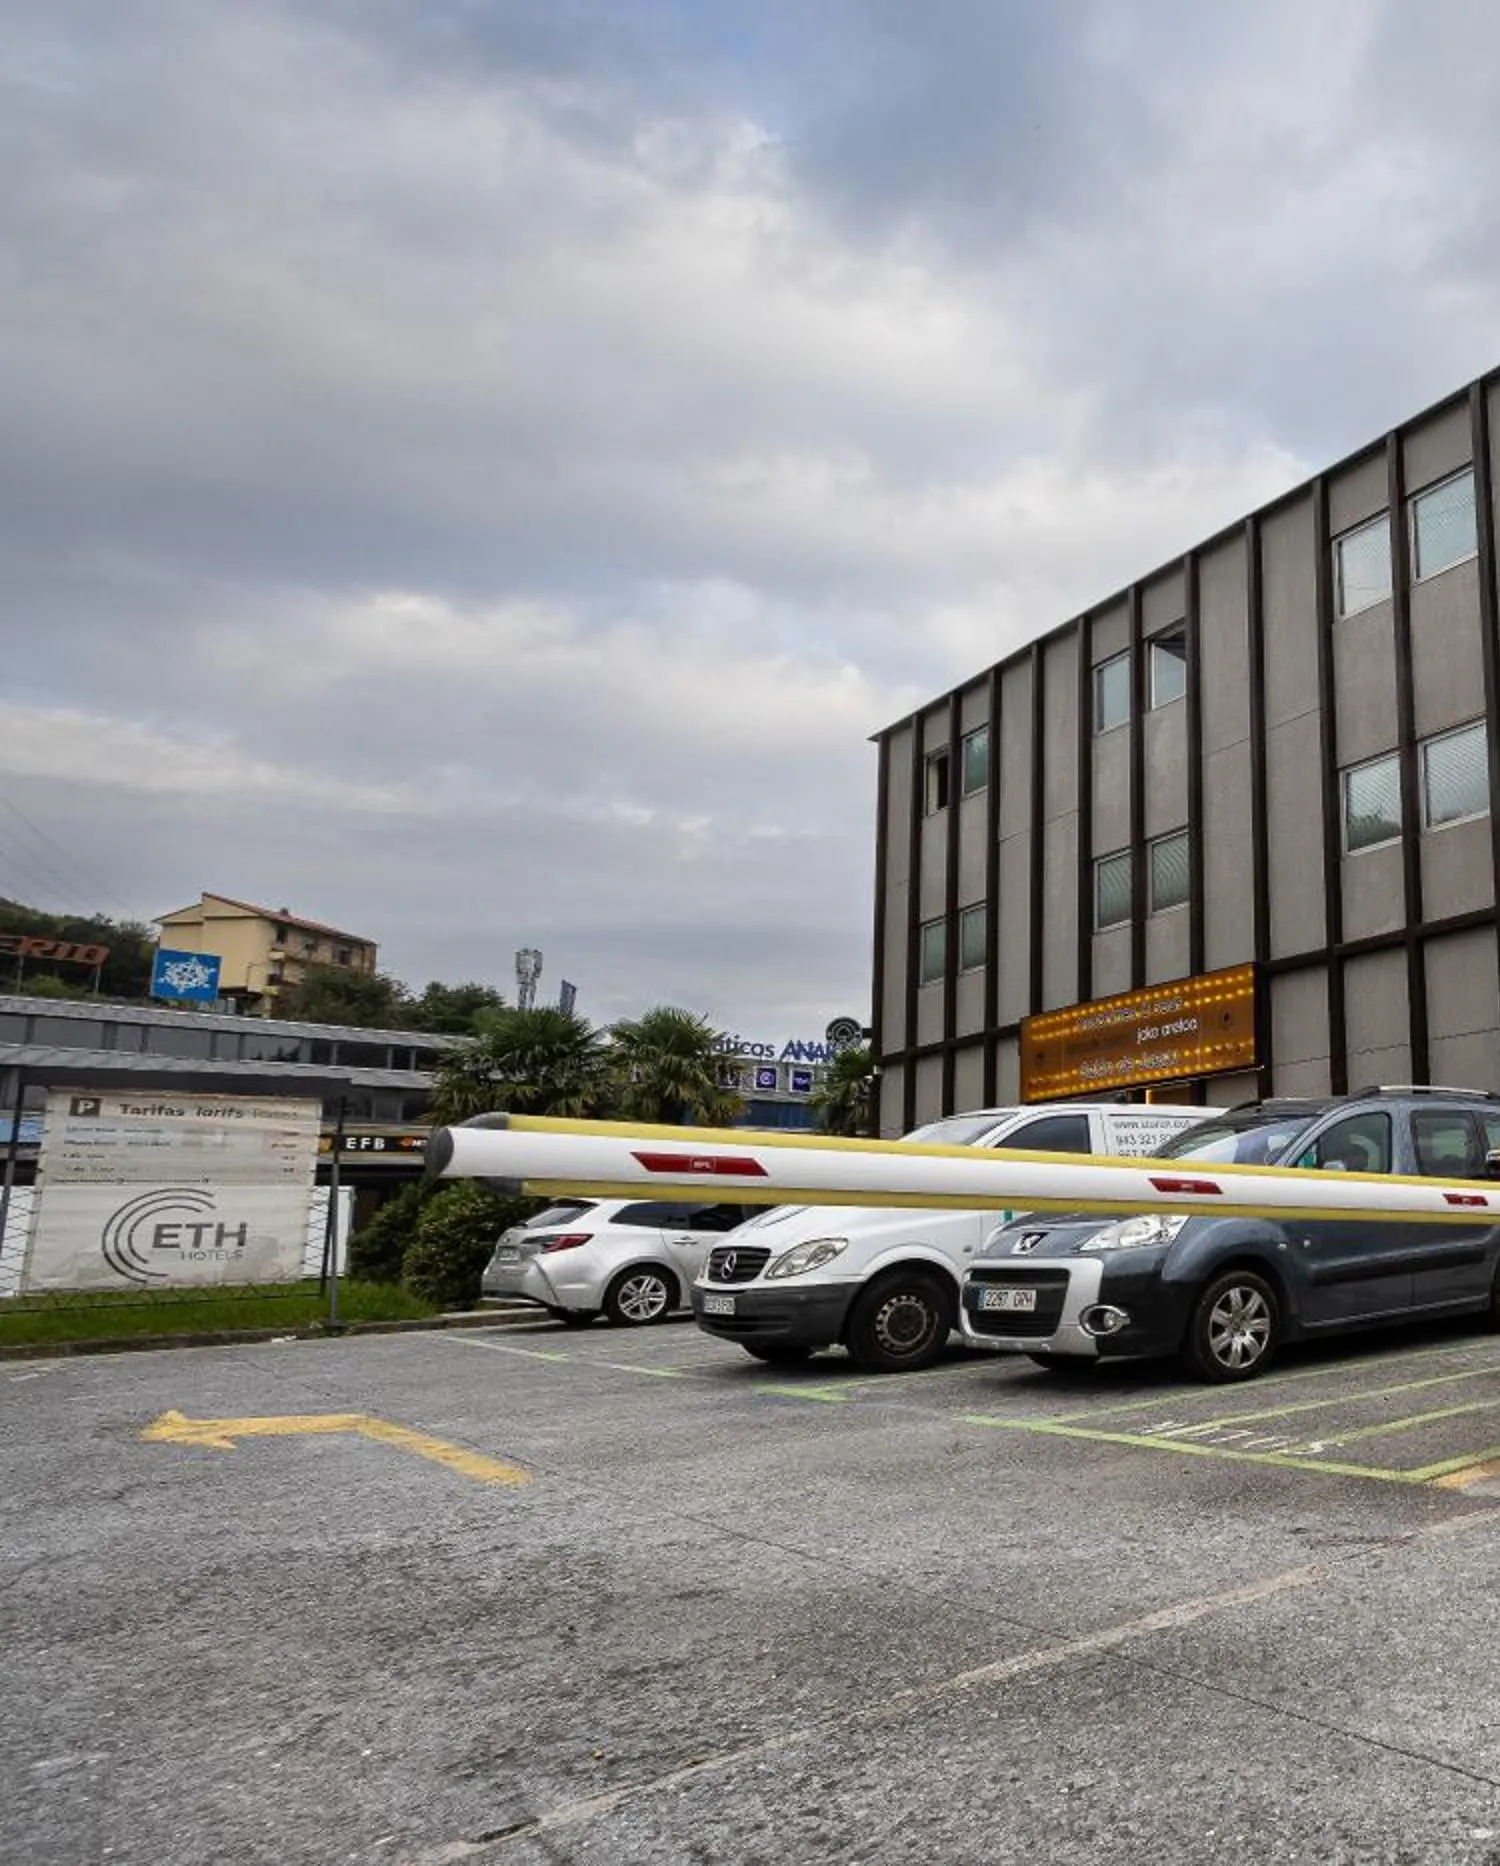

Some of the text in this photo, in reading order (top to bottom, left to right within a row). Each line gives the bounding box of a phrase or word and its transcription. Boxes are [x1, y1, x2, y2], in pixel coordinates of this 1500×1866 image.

[119, 1103, 185, 1117] Tarifas
[345, 1137, 385, 1150] EFB
[152, 1222, 248, 1249] ETH
[181, 1250, 243, 1262] HOTELS
